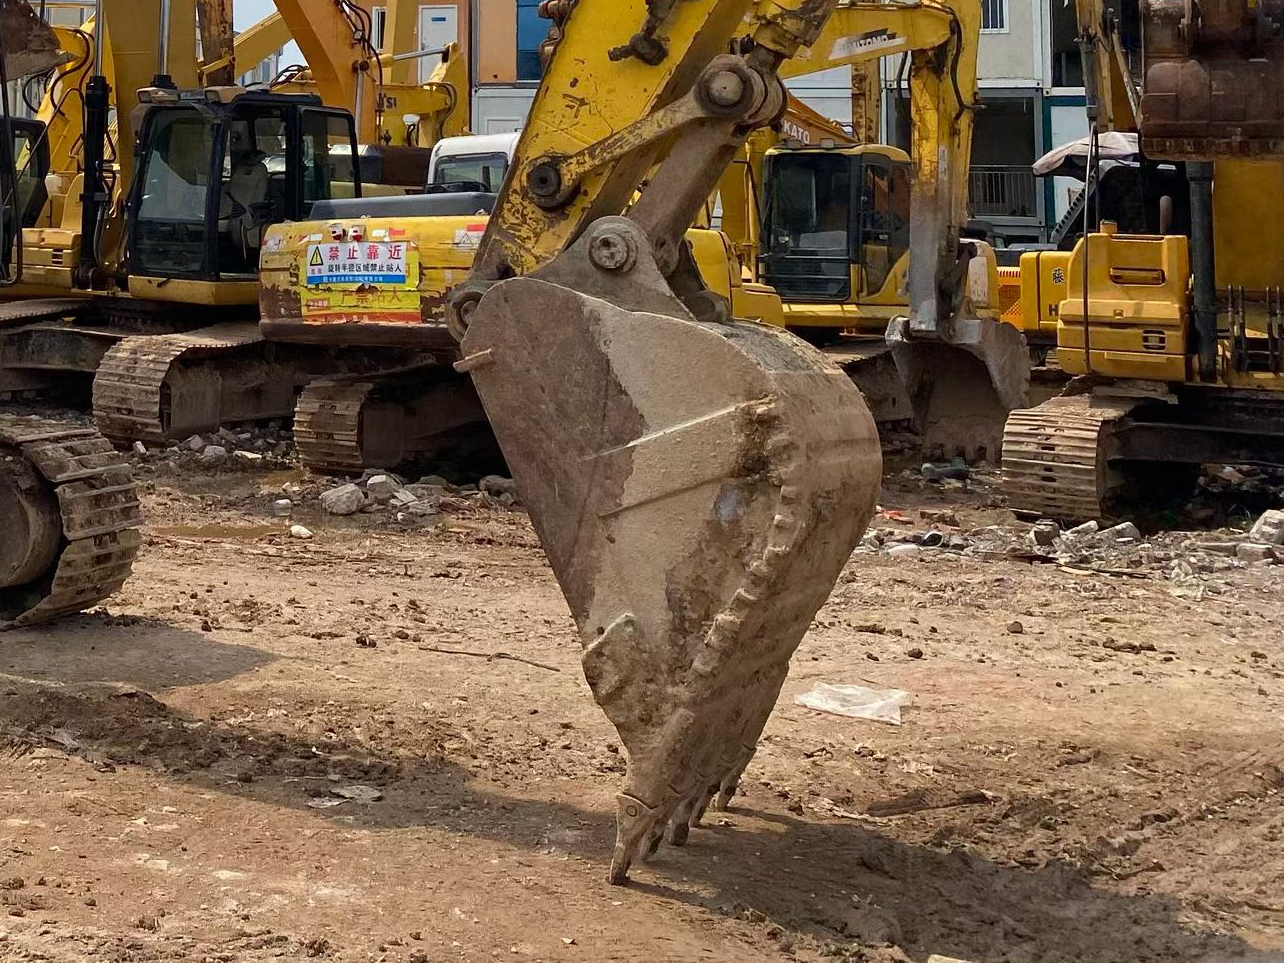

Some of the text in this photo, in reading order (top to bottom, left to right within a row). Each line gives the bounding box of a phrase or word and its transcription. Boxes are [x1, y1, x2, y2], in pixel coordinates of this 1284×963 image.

[782, 119, 810, 144] KATO
[328, 244, 402, 261] 禁止靠近
